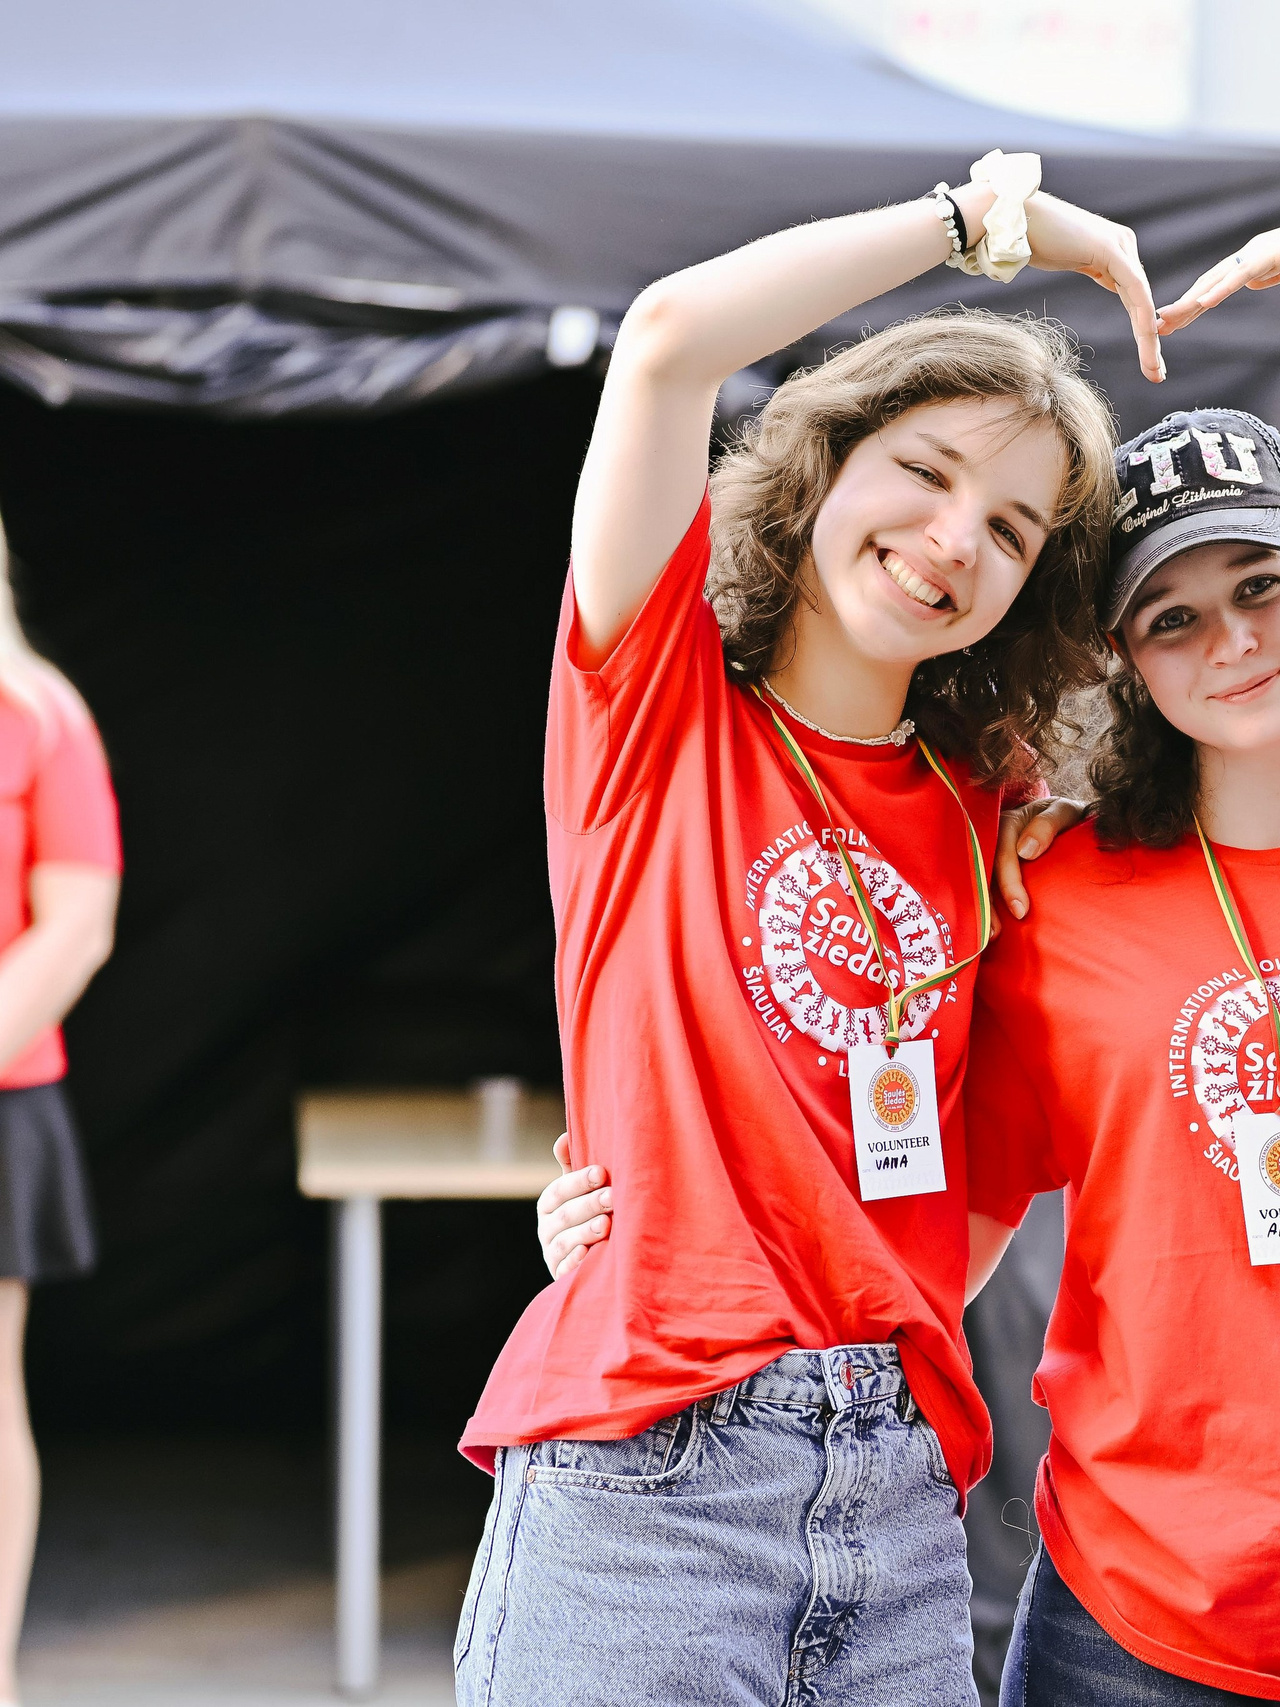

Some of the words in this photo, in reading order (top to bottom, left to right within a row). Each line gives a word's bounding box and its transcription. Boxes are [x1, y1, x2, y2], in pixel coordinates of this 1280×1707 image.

[1122, 498, 1170, 533] Original
[1172, 484, 1244, 508] Lithuania
[742, 965, 793, 1044] ŠIAULIAI
[1168, 968, 1246, 1098] INTERNATIONAL
[868, 1136, 930, 1153] VOLUNTEER
